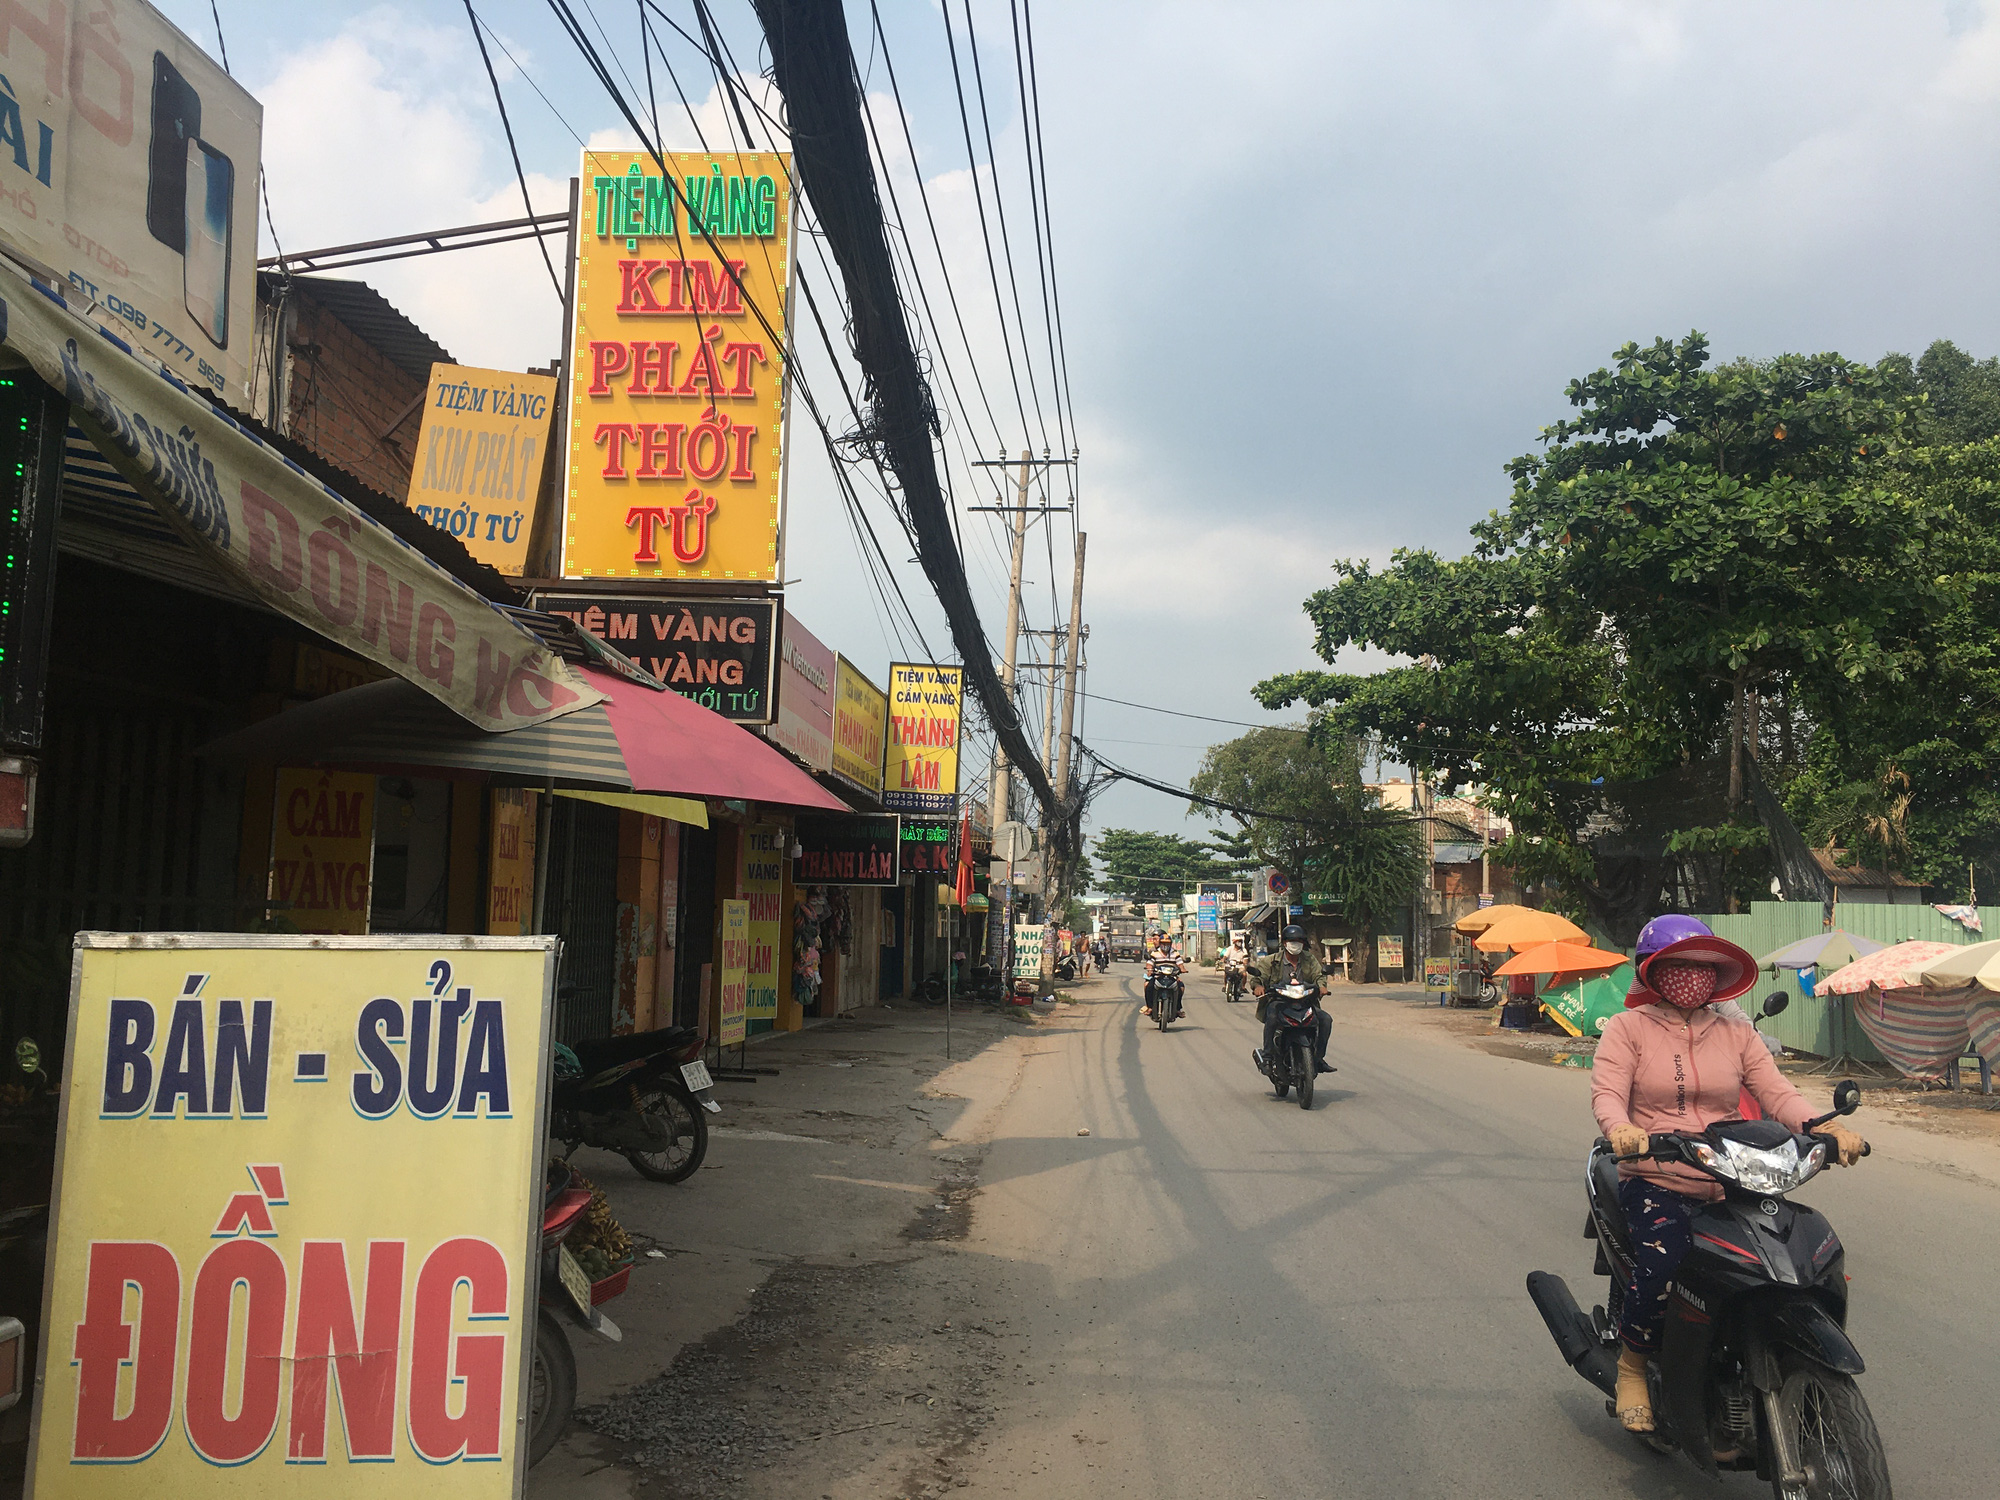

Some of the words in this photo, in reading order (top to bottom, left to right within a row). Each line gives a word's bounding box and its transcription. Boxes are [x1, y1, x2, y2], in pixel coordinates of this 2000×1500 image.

[593, 162, 676, 252] TIỆM
[685, 162, 776, 237] VÀNG
[616, 259, 747, 315] KIM
[152, 321, 195, 362] 7777
[198, 358, 226, 392] 969
[587, 323, 768, 398] PHÁT
[435, 381, 488, 415] TIỆM
[492, 384, 546, 420] VÀNG
[593, 405, 758, 481] THỚI
[421, 424, 473, 495] KIM
[468, 424, 536, 503] PHÁT
[486, 511, 524, 544] TỨ
[624, 488, 718, 563] TỨ
[240, 480, 457, 690] ĐỒNG
[650, 608, 756, 644] VÀNG
[651, 652, 744, 686] VÀNG
[728, 688, 759, 713] TỨ
[924, 689, 955, 706] VÀNG
[891, 708, 956, 748] THÀNH
[901, 753, 941, 791] LÂM
[499, 823, 520, 860] KIM
[275, 844, 366, 911] VÀNG
[747, 859, 780, 881] VÀNG
[858, 843, 892, 879] LÂM
[492, 876, 520, 922] PHÁT
[747, 938, 772, 974] LÂM
[1015, 955, 1038, 967] TÂY
[99, 973, 273, 1120] BÁN
[293, 1052, 328, 1082] -
[350, 960, 513, 1120] SỬA
[1673, 1053, 1686, 1082] Sports
[1676, 1084, 1688, 1116] Fashion
[70, 1163, 510, 1467] ĐỒNG
[1676, 1281, 1706, 1312] YAMAHA
